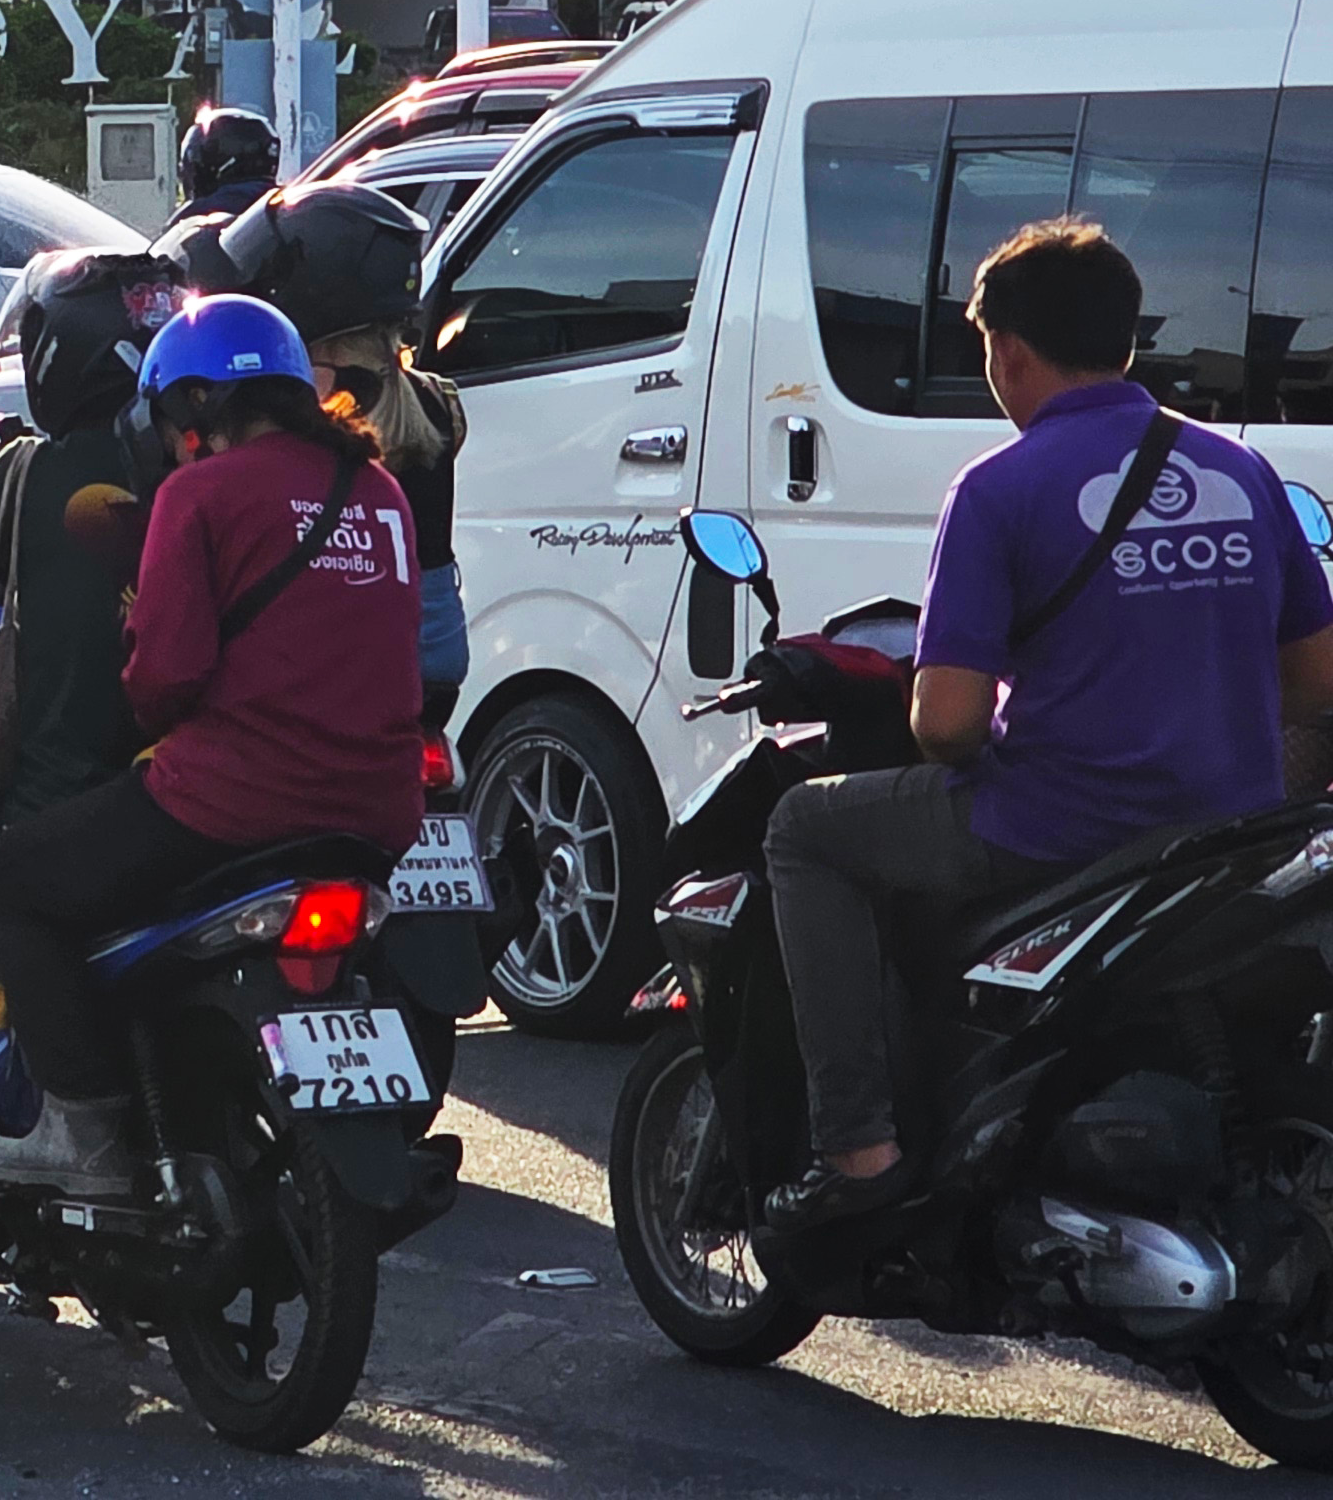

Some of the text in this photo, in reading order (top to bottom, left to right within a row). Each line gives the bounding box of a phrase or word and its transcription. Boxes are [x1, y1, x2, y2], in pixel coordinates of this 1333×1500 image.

[396, 881, 473, 905] 3495
[994, 920, 1072, 969] CLICK
[301, 1073, 413, 1108] 7210
